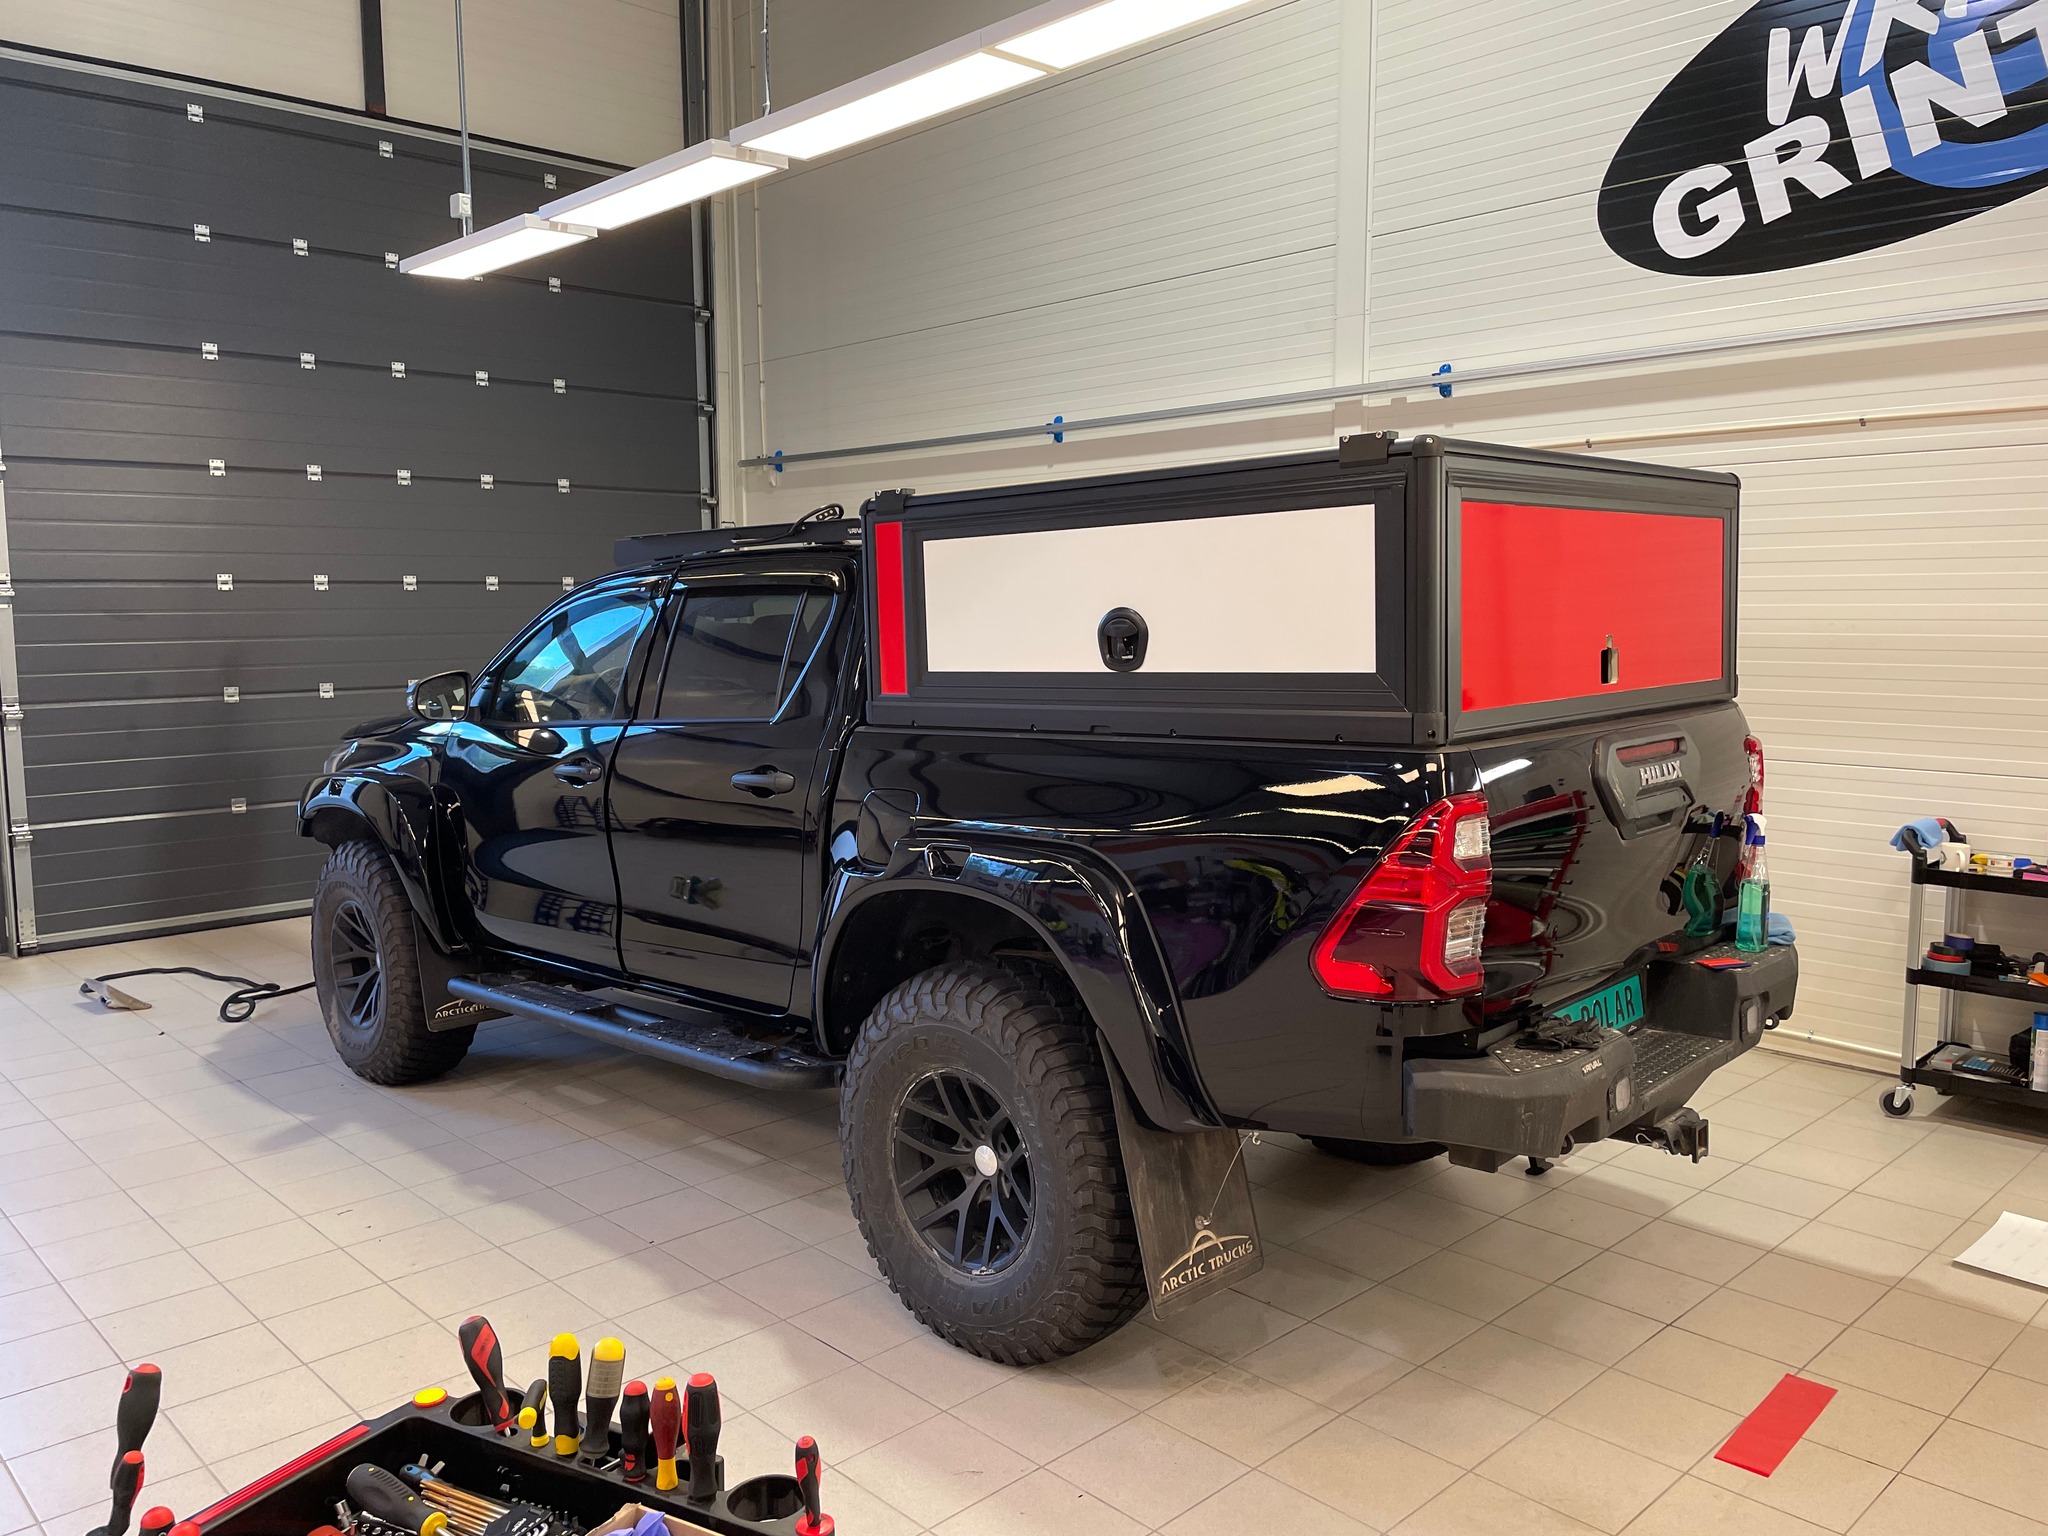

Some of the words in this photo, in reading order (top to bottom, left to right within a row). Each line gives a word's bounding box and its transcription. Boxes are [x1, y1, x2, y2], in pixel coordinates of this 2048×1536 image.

[1639, 760, 1683, 786] HILUX
[434, 1005, 470, 1019] ARCTIC
[1160, 1262, 1206, 1295] ARCTIC
[1208, 1240, 1253, 1270] TRUCKS
